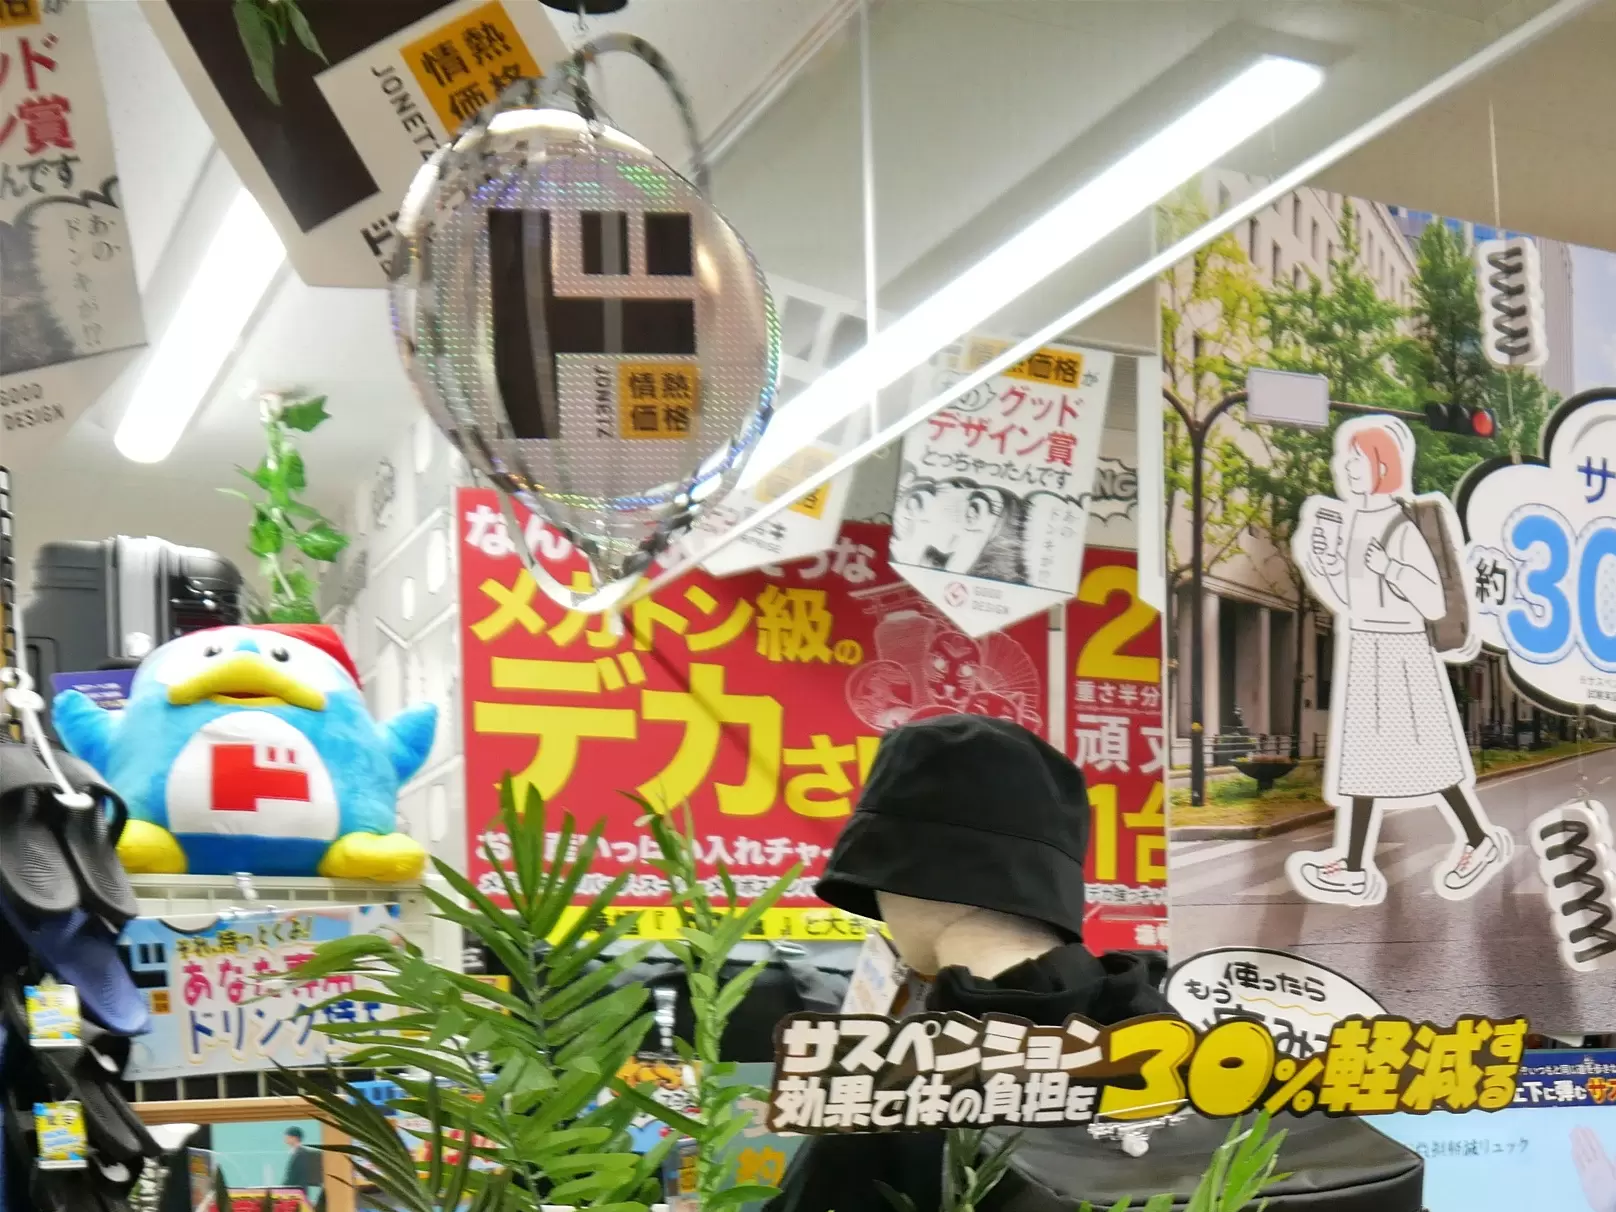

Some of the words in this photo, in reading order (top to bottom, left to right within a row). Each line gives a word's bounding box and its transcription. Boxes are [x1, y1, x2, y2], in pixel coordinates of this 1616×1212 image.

[626, 370, 690, 400] 情熱
[1000, 385, 1084, 427] グッド
[629, 406, 690, 434] 価格
[926, 411, 1078, 468] デザイン賞
[921, 446, 1073, 490] とっちゃったんです
[782, 1018, 1102, 1075] サスペンション
[772, 1070, 1095, 1128] 効果で体の負担を
